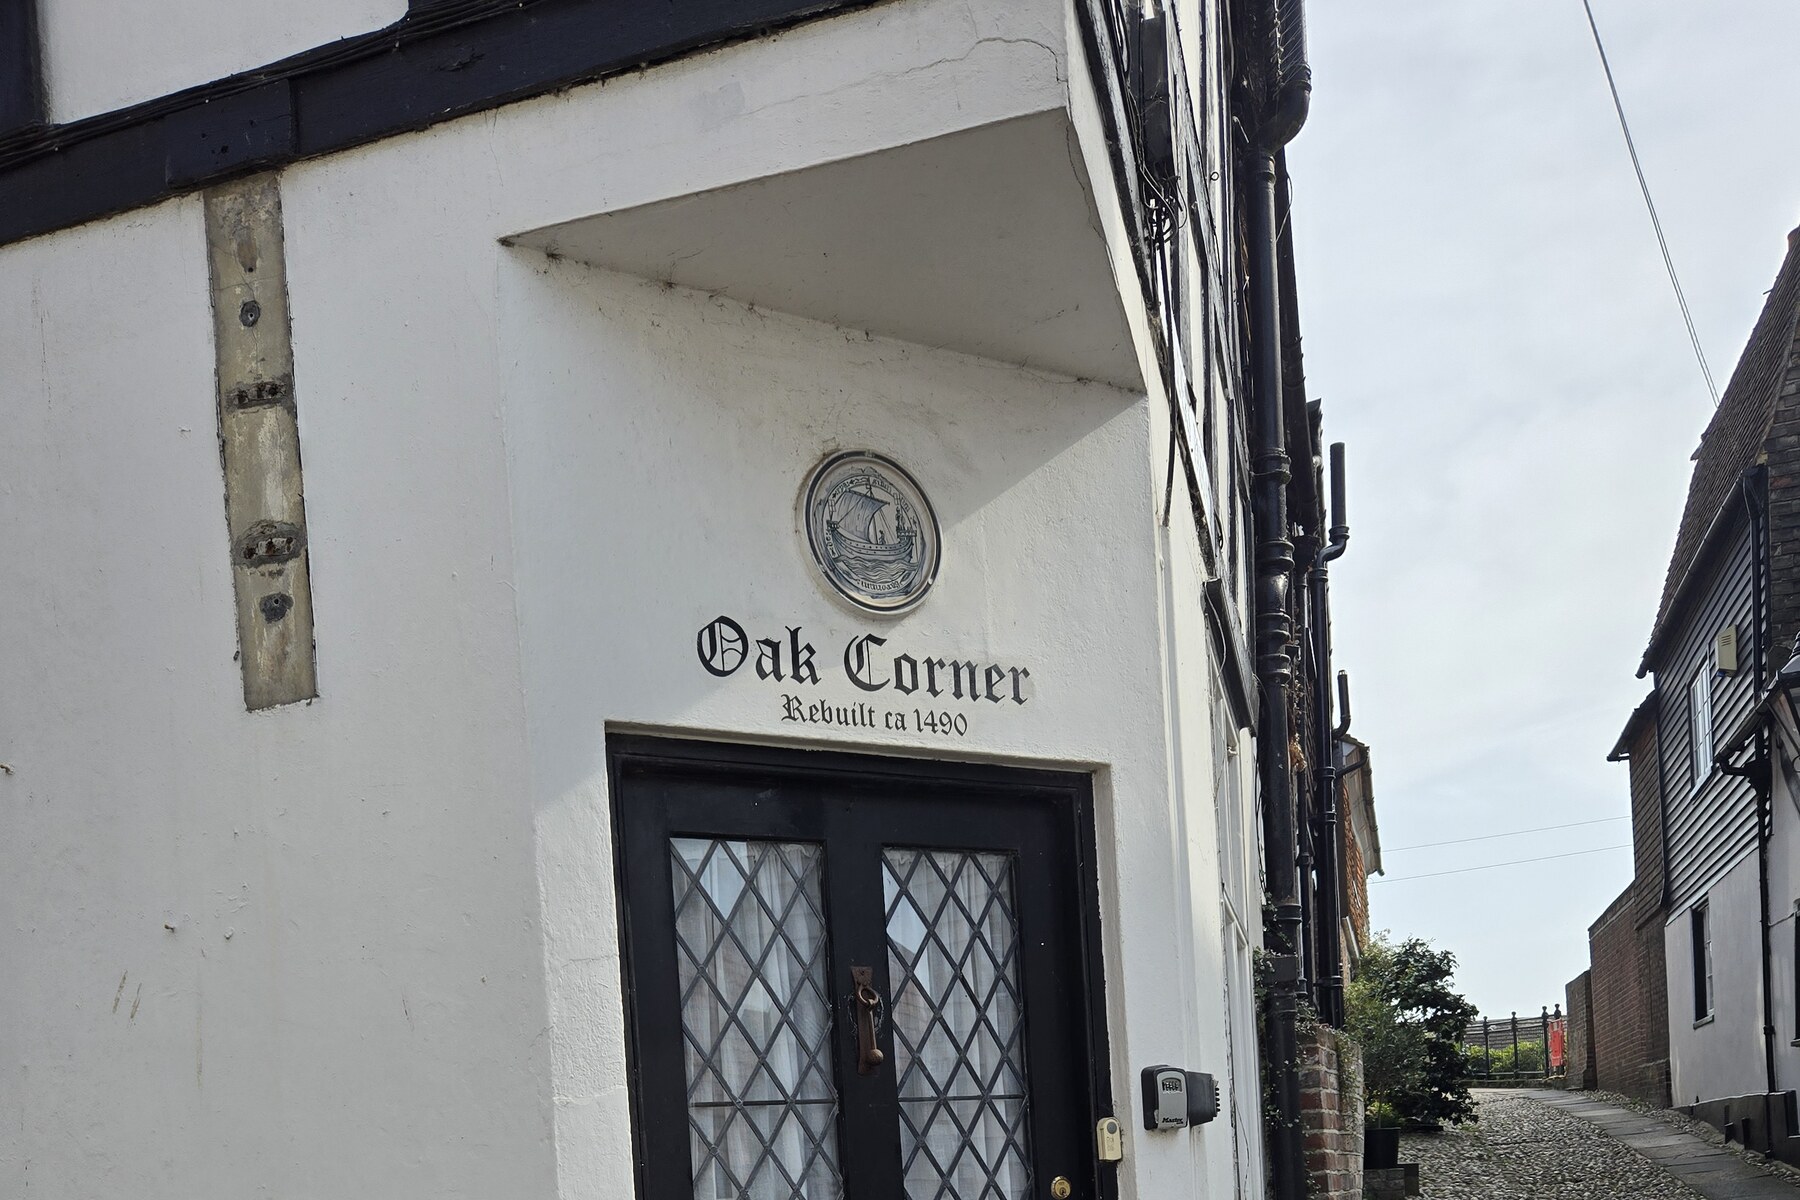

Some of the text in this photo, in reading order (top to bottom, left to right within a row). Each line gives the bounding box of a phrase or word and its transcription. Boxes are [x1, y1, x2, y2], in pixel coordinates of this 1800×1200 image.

[696, 615, 1031, 706] Oak Corner
[780, 693, 968, 737] Rebuilt ca 1490
